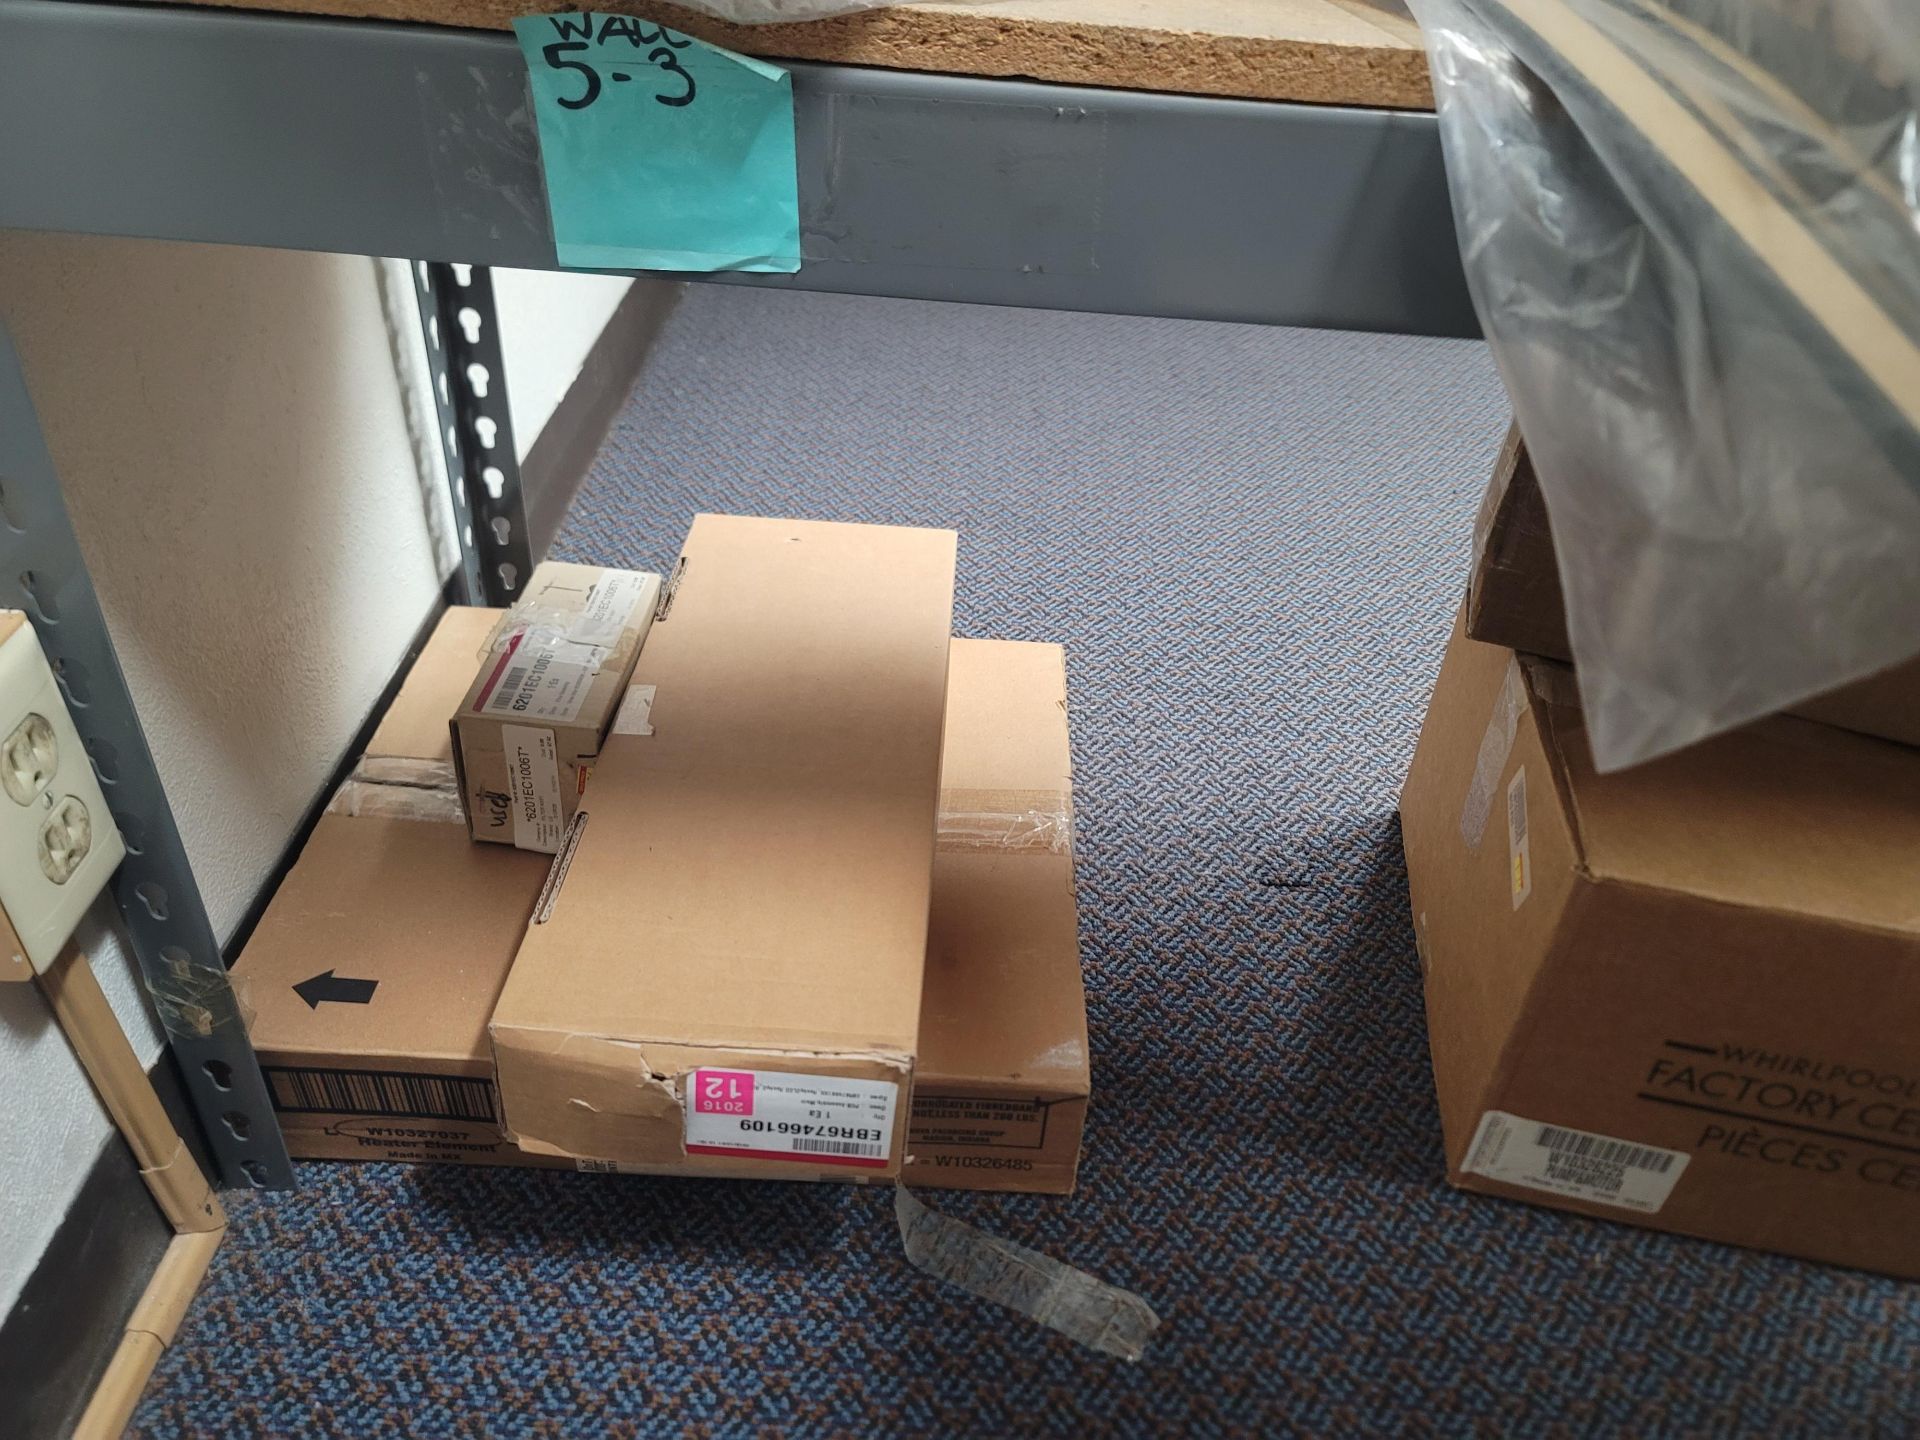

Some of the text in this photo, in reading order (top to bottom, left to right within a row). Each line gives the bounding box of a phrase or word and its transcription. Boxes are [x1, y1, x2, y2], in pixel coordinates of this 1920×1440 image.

[704, 1077, 744, 1100] 12
[1646, 1058, 1857, 1121] FACTORY
[703, 1101, 744, 1112] 2016
[366, 1127, 471, 1141] W10327037
[739, 1119, 882, 1141] EBR67466109
[357, 1137, 497, 1153] Heater Element
[1696, 1123, 1848, 1173] PIÈCES
[935, 1154, 1034, 1172] W10326485
